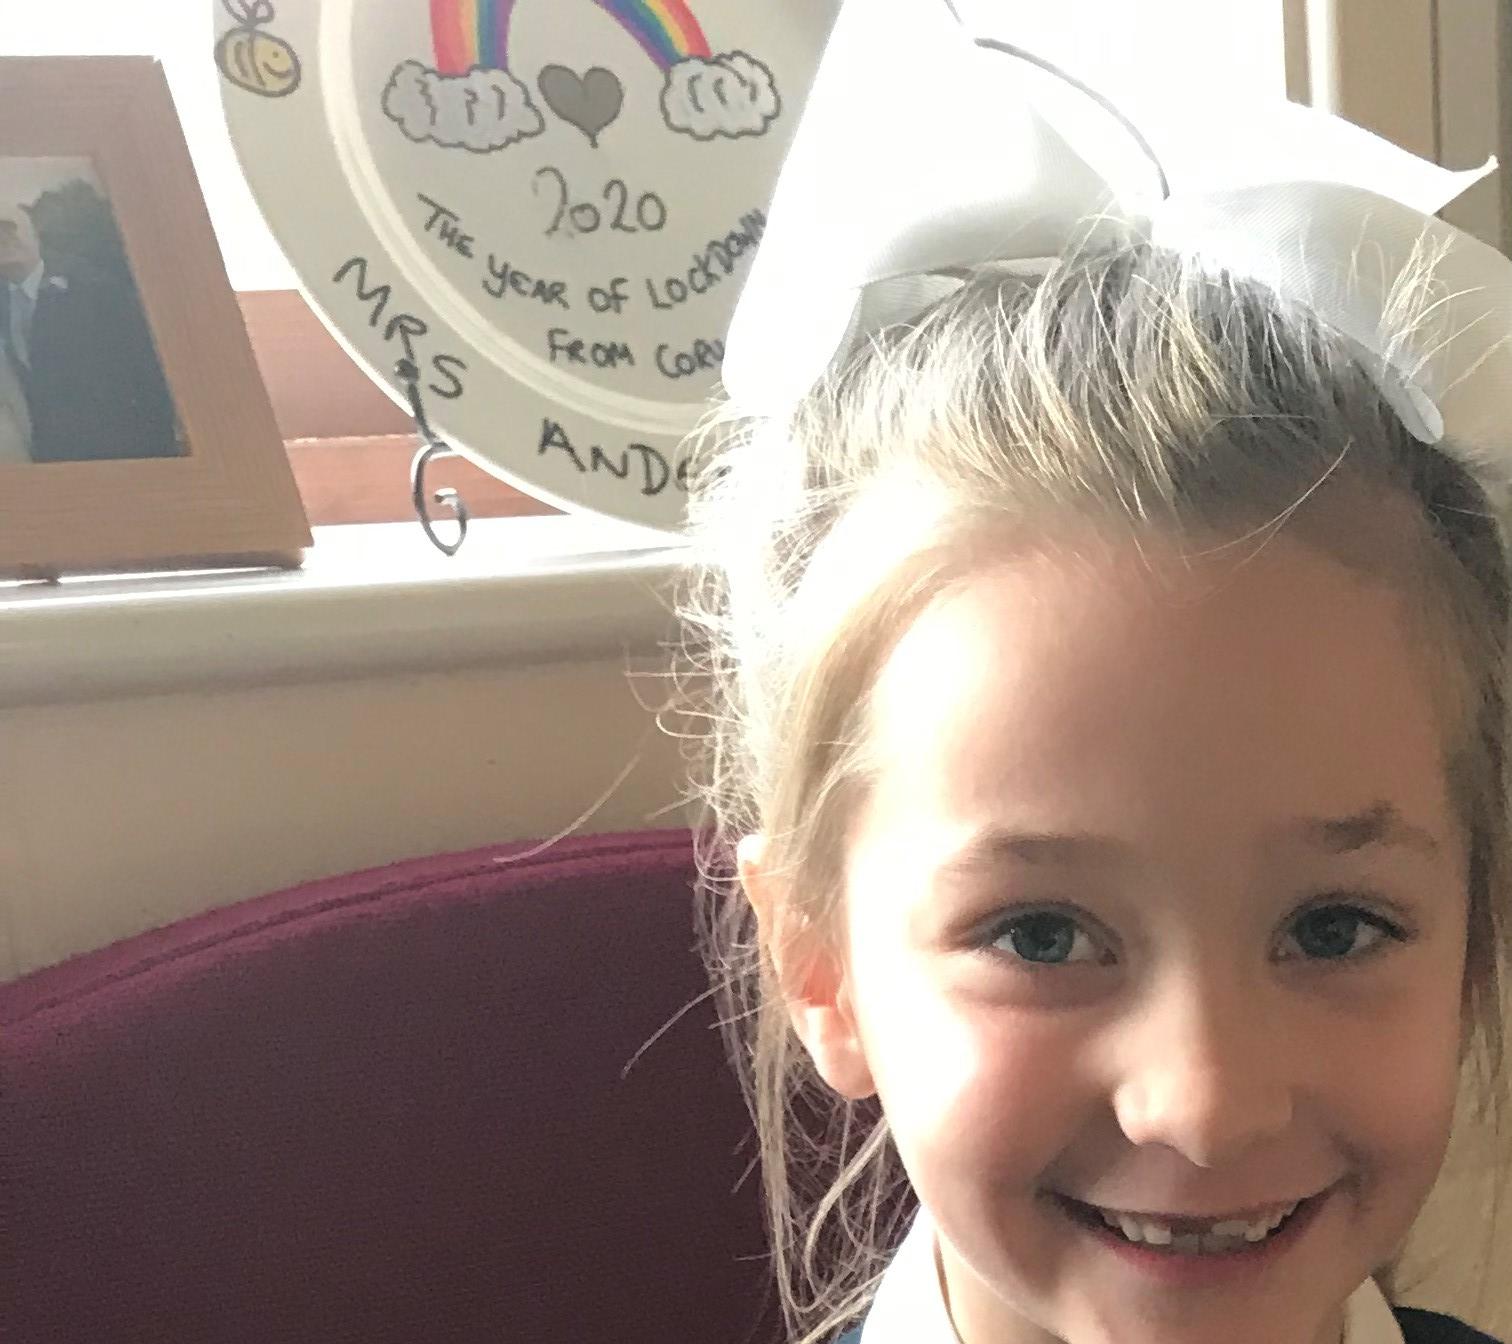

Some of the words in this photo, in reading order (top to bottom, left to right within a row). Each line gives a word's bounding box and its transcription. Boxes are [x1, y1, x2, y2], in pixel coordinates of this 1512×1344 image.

[532, 165, 668, 239] 2020
[416, 192, 475, 259] THE
[481, 253, 570, 310] YEAR
[587, 276, 630, 314] OF
[332, 256, 467, 400] MRS
[546, 327, 636, 367] FROM
